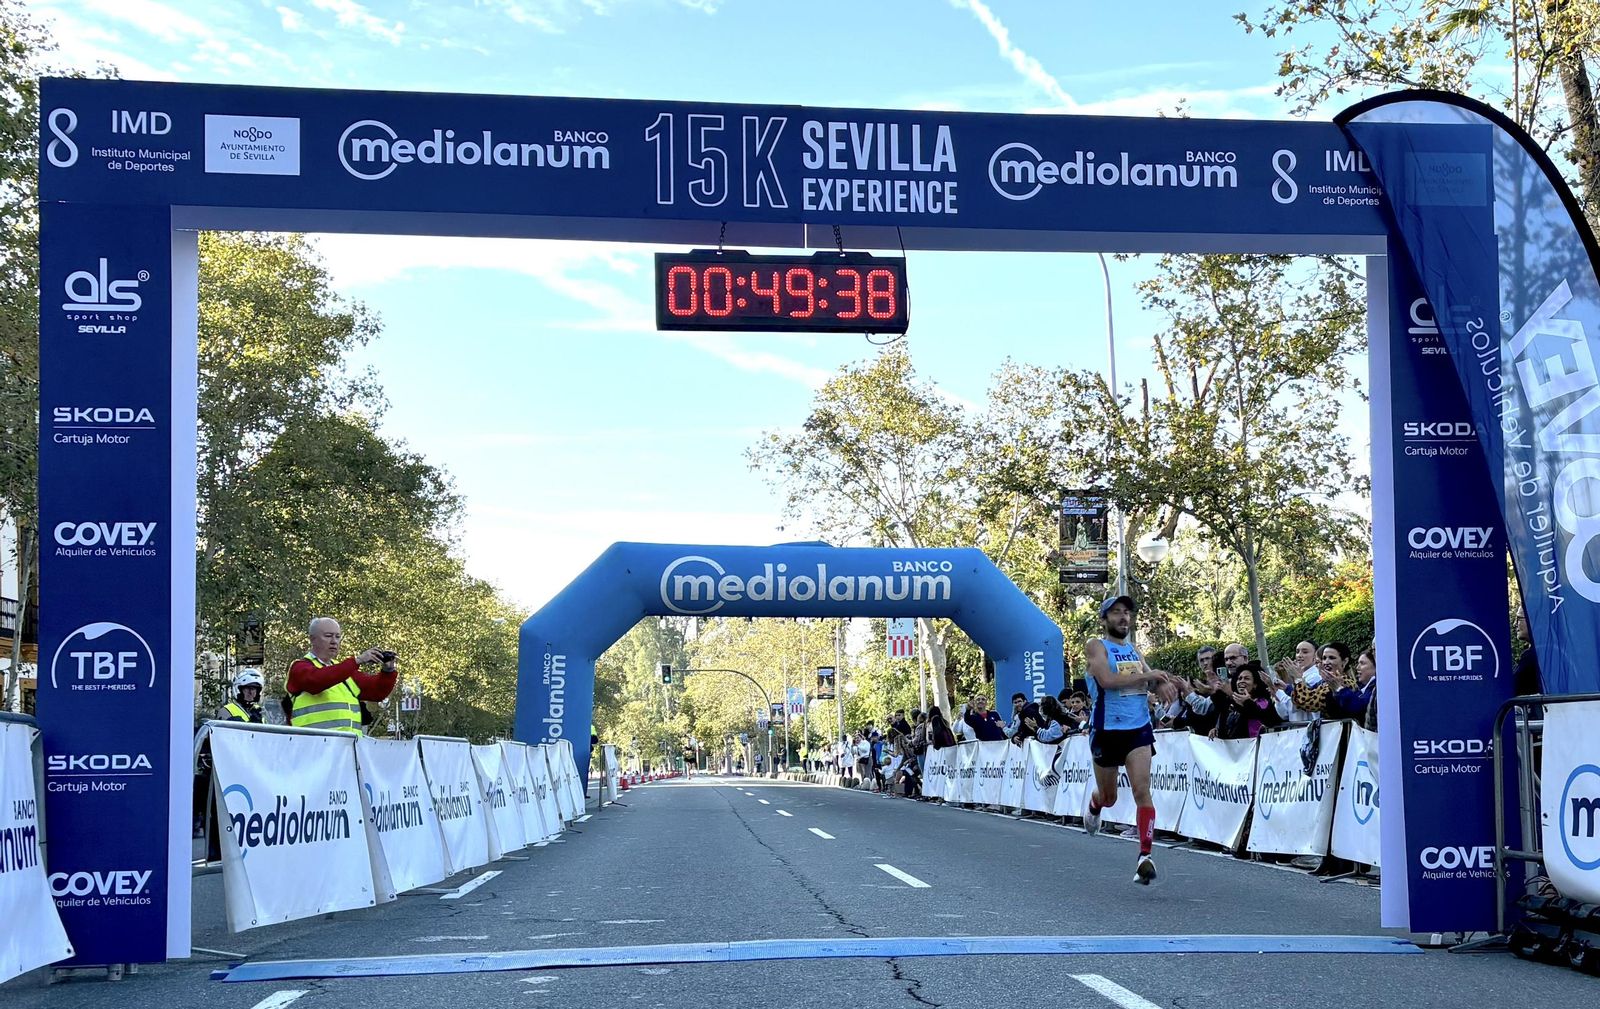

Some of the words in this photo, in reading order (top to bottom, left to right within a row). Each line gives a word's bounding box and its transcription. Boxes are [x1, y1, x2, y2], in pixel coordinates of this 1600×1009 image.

[111, 109, 172, 135] IMD
[554, 131, 609, 144] BANCO
[351, 129, 609, 169] mediolanum
[802, 120, 958, 172] SEVILLA
[92, 147, 136, 158] Instituto
[139, 149, 191, 161] Municipal
[243, 151, 275, 160] SEVILLA
[645, 112, 788, 208] 15K
[1186, 151, 1236, 164] BANCO
[108, 160, 122, 170] de
[125, 161, 175, 172] Deportes
[1000, 151, 1237, 188] mediolanum
[803, 178, 958, 214] EXPERIENCE
[1308, 185, 1346, 194] Instituto
[1323, 196, 1335, 205] de
[1337, 196, 1380, 206] Deportes
[667, 265, 897, 319] 00:49:38
[78, 325, 126, 333] SEVILLA
[53, 433, 93, 445] Cartuja
[96, 434, 130, 444] Motor
[1404, 446, 1438, 457] Cartuja
[1439, 446, 1469, 455] Motor
[54, 521, 157, 546] COVEY
[1408, 527, 1494, 549] COVEY
[55, 547, 93, 557] Alquiler
[94, 547, 107, 556] de
[1409, 551, 1440, 559] Alquiler
[1441, 551, 1453, 559] de
[893, 560, 953, 573] BANCO
[674, 563, 951, 601] mediolanum
[1425, 645, 1483, 671] TBF
[70, 652, 138, 679] TBF
[543, 653, 551, 685] BANCO
[1414, 764, 1448, 775] Cartuja
[1451, 763, 1481, 773] Motor
[47, 781, 88, 794] Cartuja
[91, 781, 127, 792] Motor
[1422, 871, 1454, 880] Alquiler
[1455, 870, 1467, 879] de
[48, 870, 152, 896] COVEY
[87, 897, 101, 906] de
